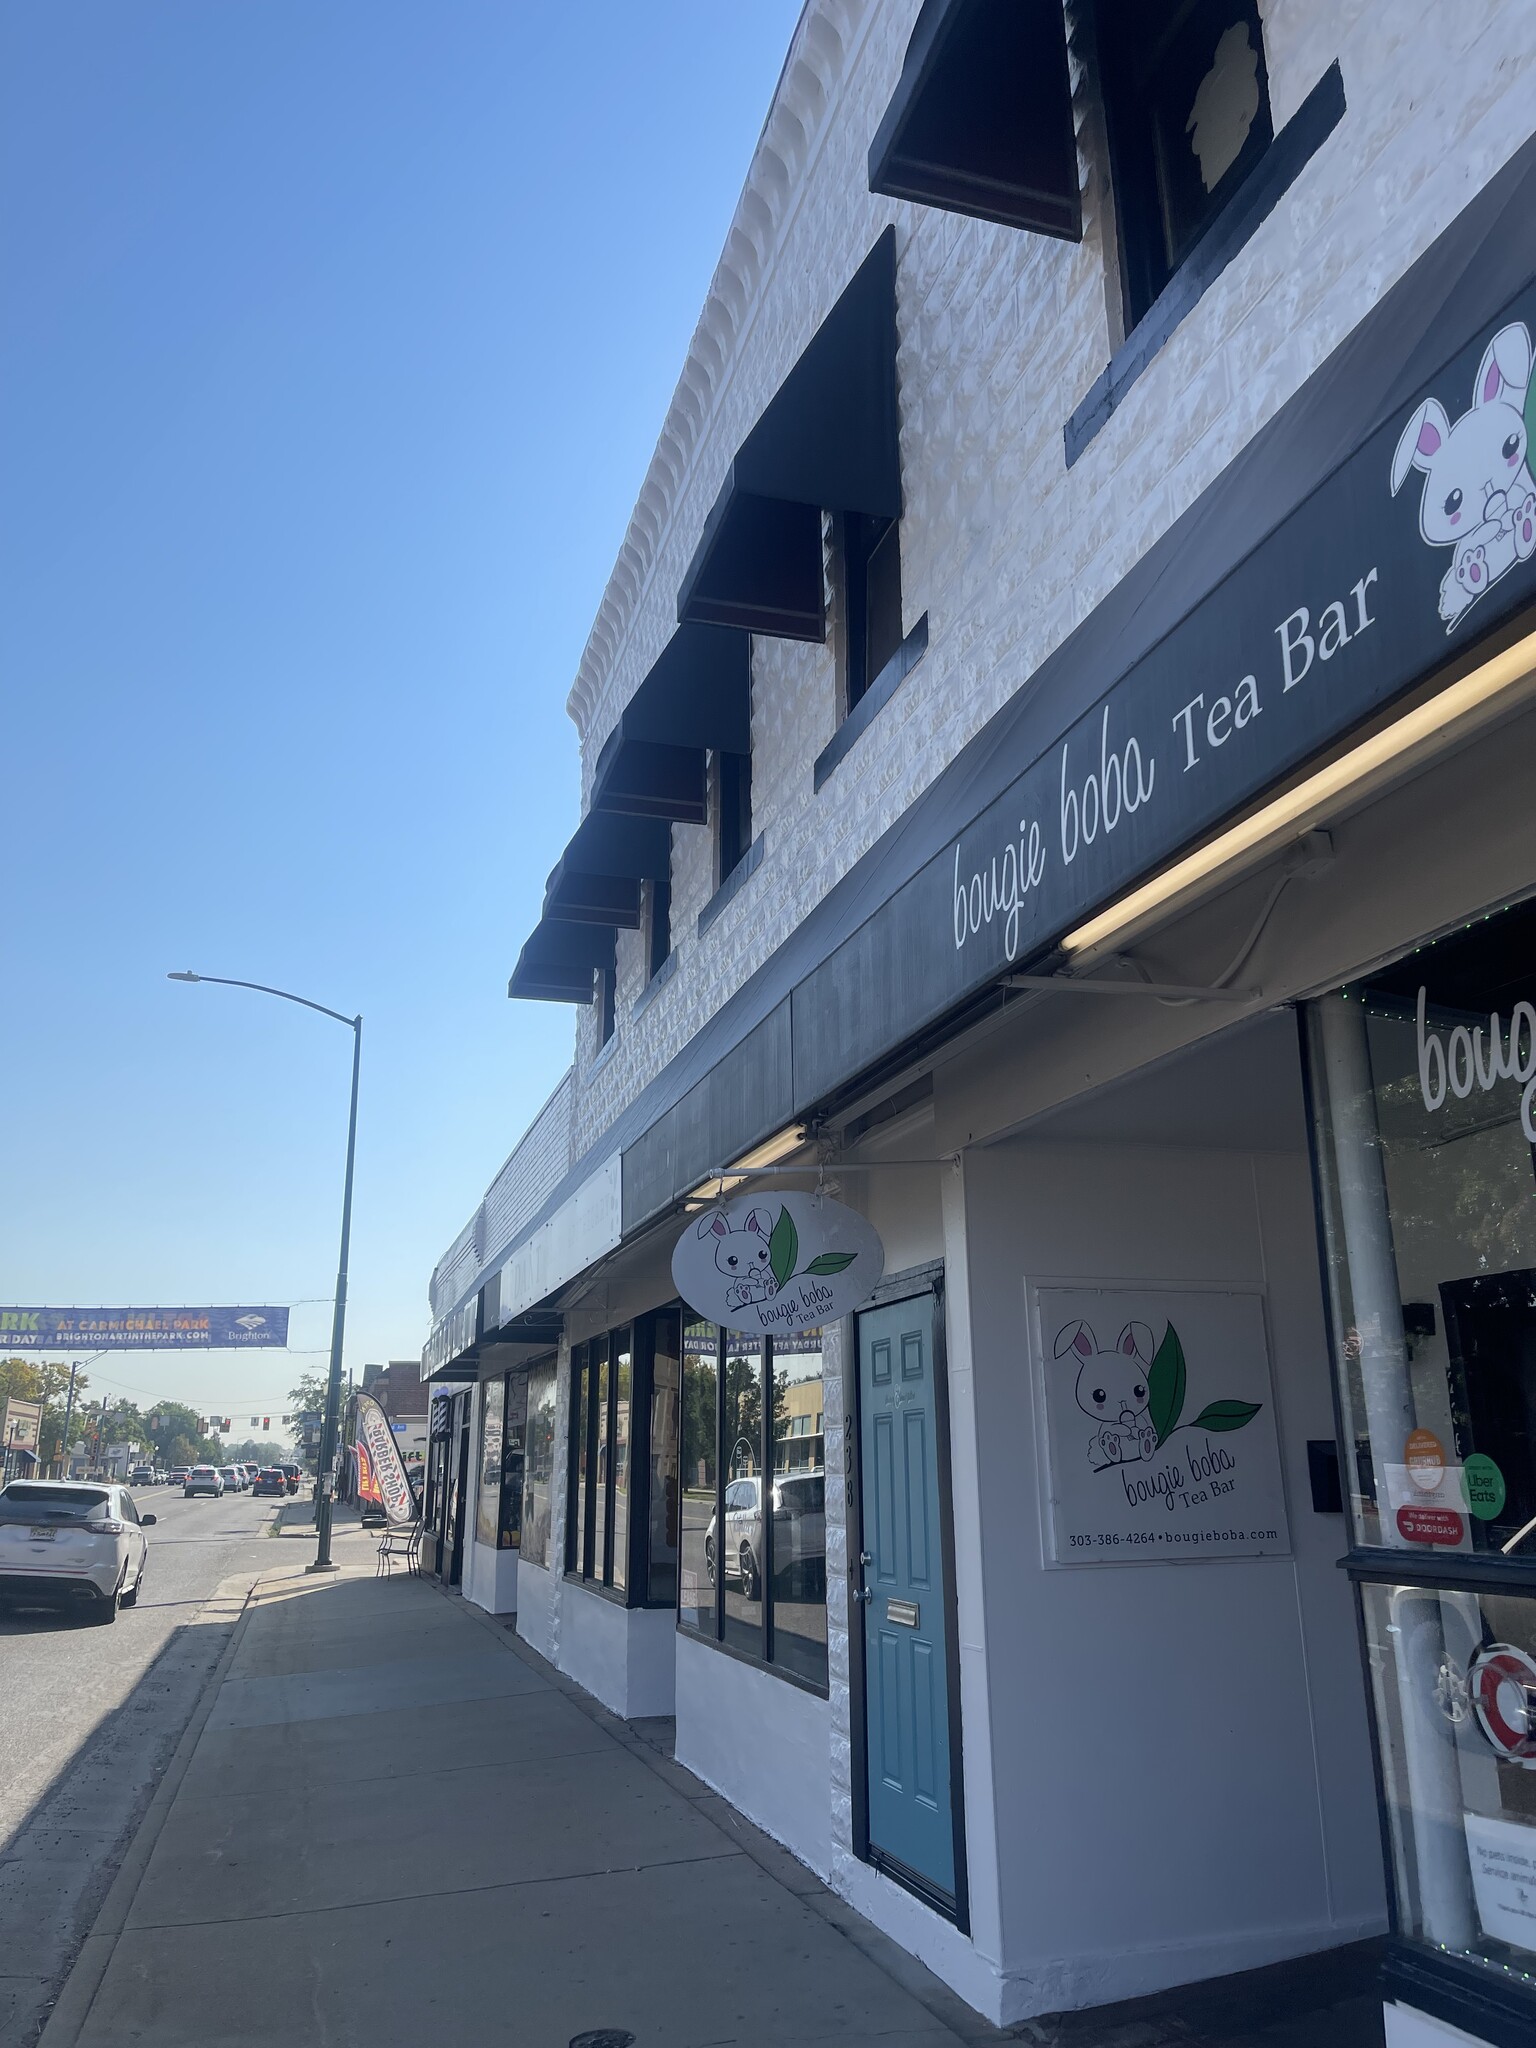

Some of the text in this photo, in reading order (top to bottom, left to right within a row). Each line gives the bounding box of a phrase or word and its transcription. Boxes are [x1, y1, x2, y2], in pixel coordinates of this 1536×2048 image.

[953, 566, 1378, 961] bougie boba Tea Bar
[756, 1280, 833, 1327] bougie boba
[796, 1302, 834, 1324] Tea Bar
[57, 1317, 209, 1331] AT CARMICHAEL PARK
[56, 1331, 209, 1341] BRIGHTONARTINTHEPARK.COM
[228, 1331, 270, 1342] Brighton
[1121, 1438, 1236, 1511] bougie boba
[1468, 1474, 1493, 1487] Uber
[1179, 1478, 1236, 1509] Tea Bar
[1470, 1489, 1496, 1502] Eats
[1416, 1523, 1458, 1535] DOORDASH
